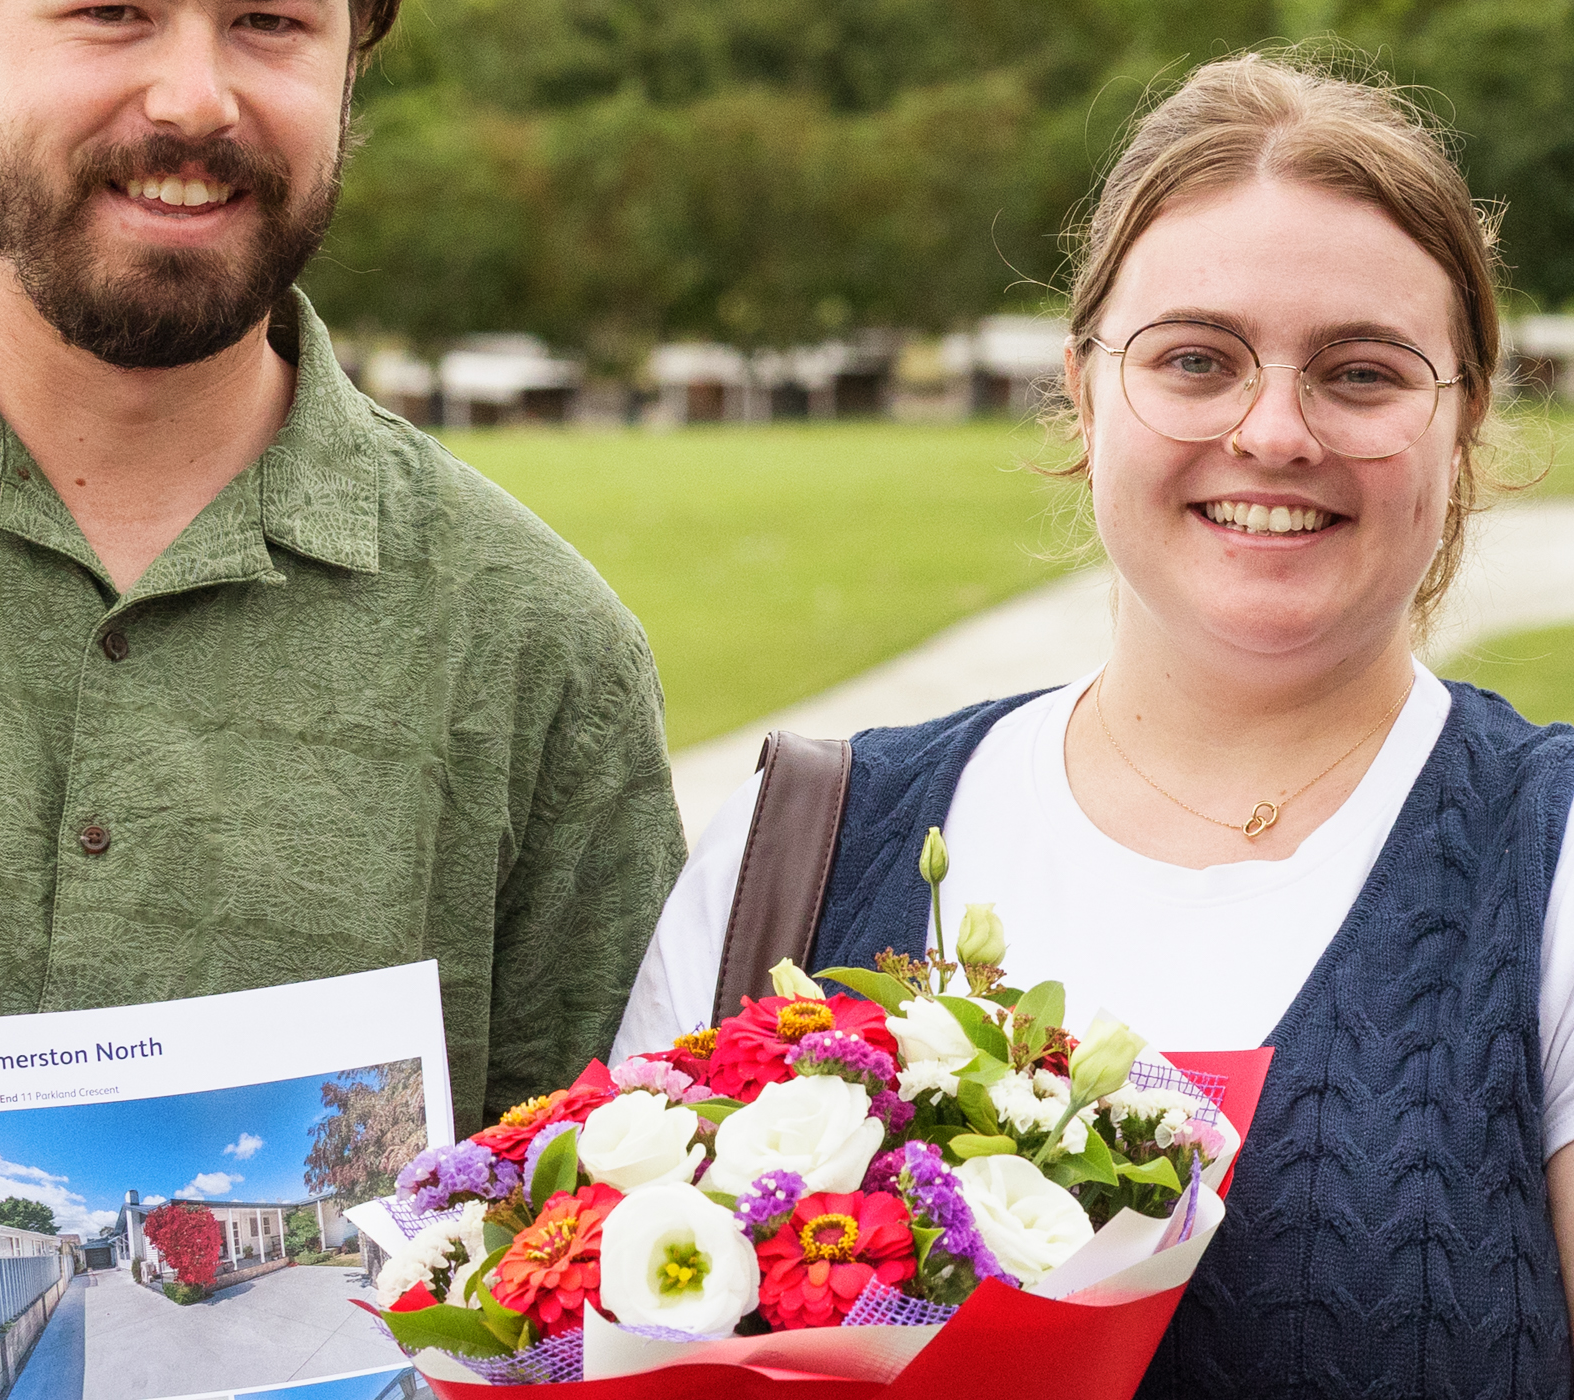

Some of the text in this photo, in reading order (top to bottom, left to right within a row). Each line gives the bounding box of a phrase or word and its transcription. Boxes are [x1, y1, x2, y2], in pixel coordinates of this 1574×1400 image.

[96, 1037, 162, 1062] North
[0, 1094, 18, 1103] End
[21, 1092, 32, 1101] 11
[36, 1089, 76, 1100] Parkland
[78, 1086, 119, 1097] Crescent
